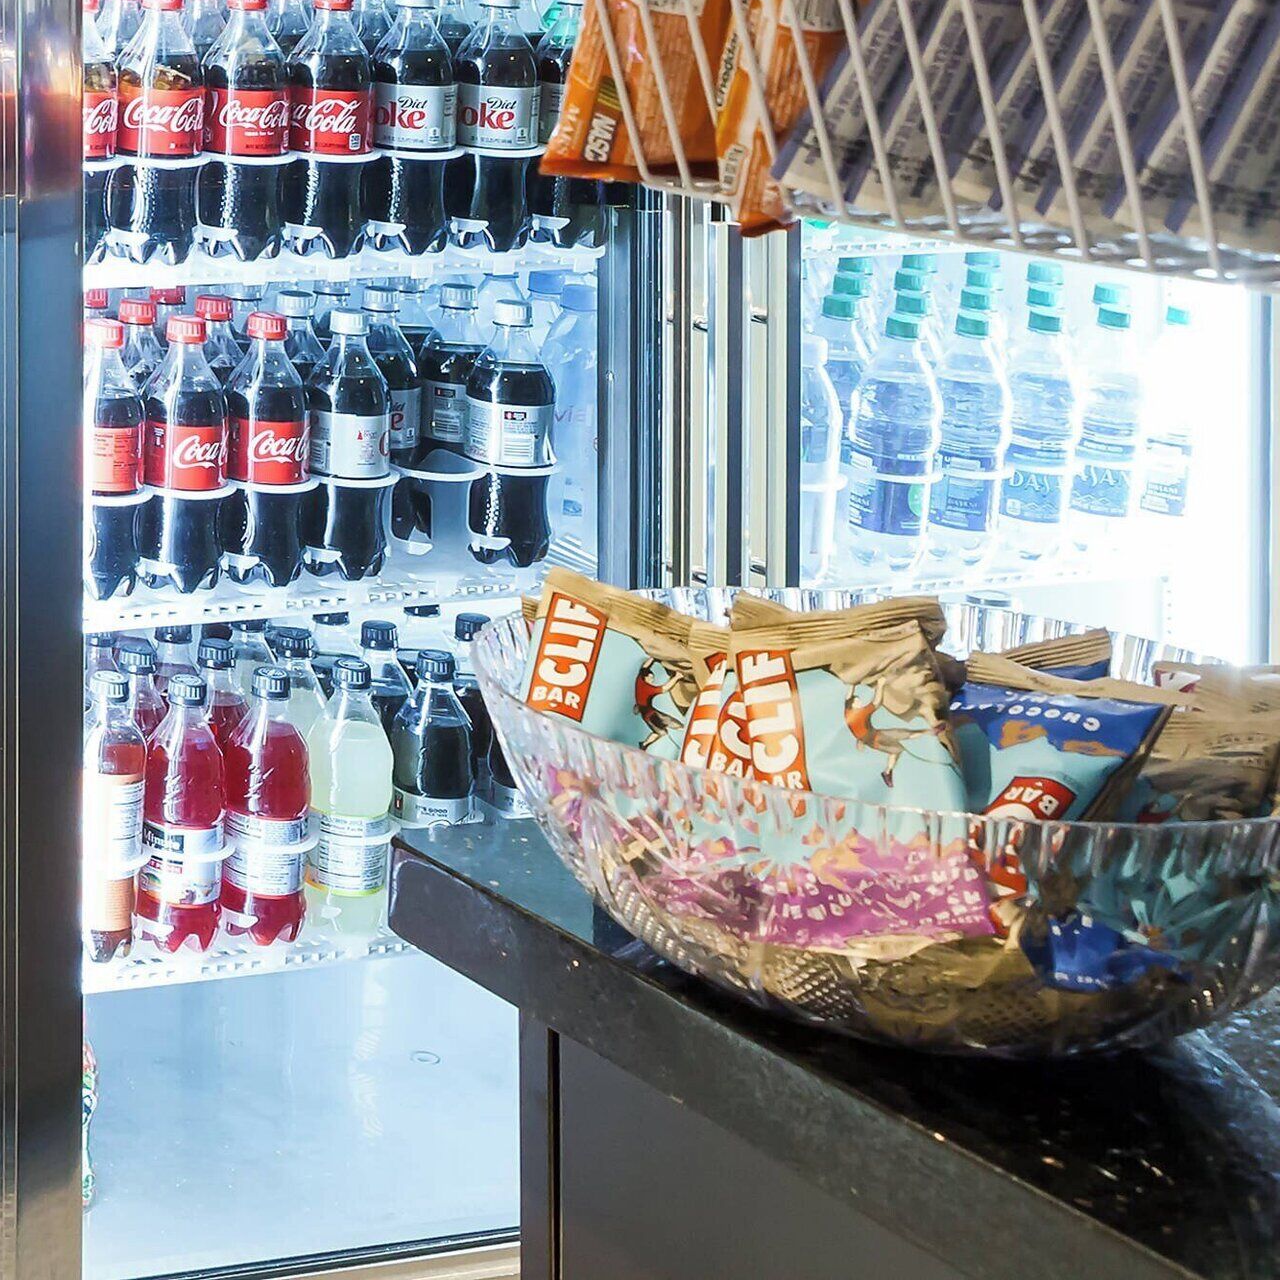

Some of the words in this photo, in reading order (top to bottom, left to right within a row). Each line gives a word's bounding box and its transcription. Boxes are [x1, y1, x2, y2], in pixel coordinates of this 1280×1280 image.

[123, 97, 204, 133] Coca-Cola
[219, 99, 289, 132] Coca-Cola
[291, 98, 361, 134] ca-Cola
[375, 101, 426, 130] oke
[397, 96, 428, 110] Diet
[458, 102, 515, 130] oke
[487, 96, 517, 110] Diet
[173, 434, 229, 469] Coca-C
[251, 426, 311, 463] Coca-C
[538, 598, 601, 687] CLIF
[531, 685, 582, 710] BAR
[684, 659, 727, 767] CLIF
[741, 651, 799, 775] CLIF
[760, 770, 804, 790] AR
[1003, 786, 1060, 816] BAR
